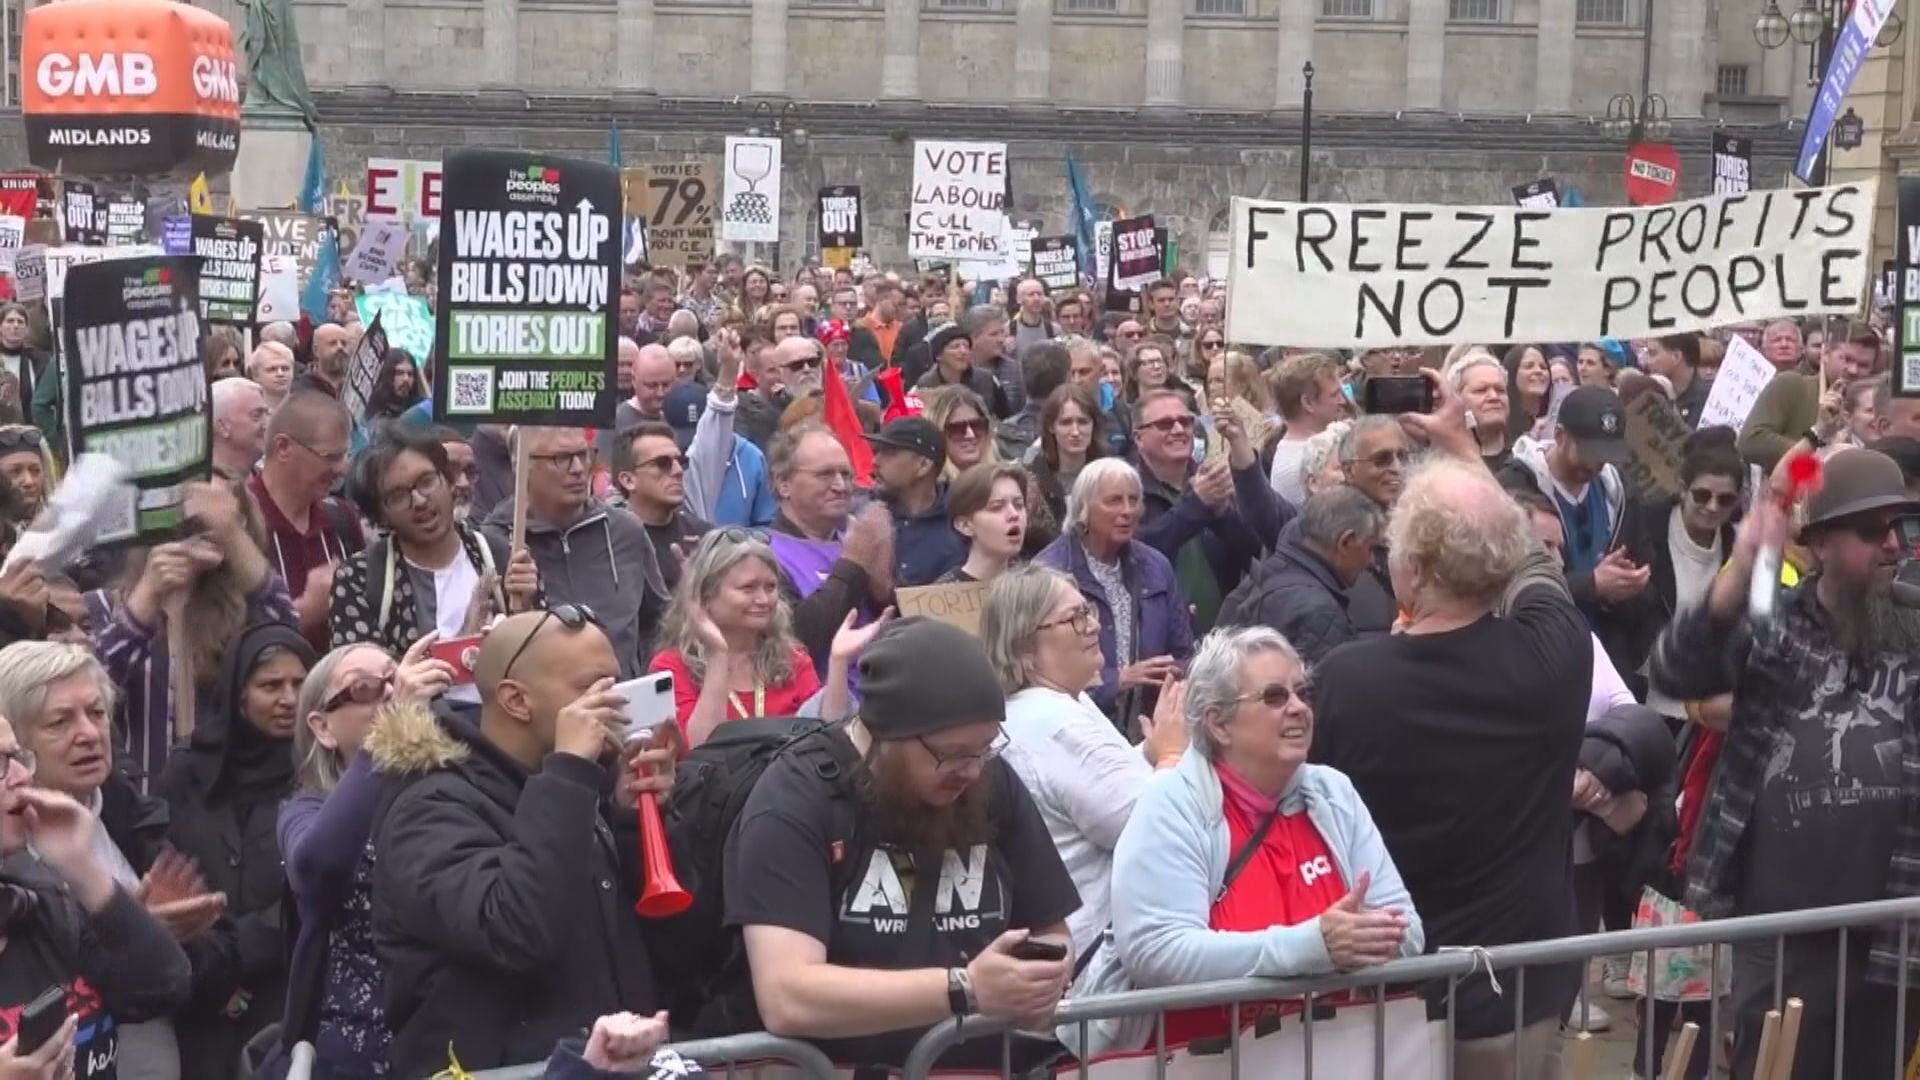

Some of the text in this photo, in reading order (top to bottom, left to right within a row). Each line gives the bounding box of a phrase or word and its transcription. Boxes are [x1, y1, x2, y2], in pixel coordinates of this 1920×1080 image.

[37, 53, 157, 96] GMB
[193, 55, 239, 102] GMB
[48, 129, 151, 145] MIDLANDS
[653, 165, 702, 176] TORIES
[925, 149, 1001, 175] VOTE
[1714, 153, 1749, 180] TORIES
[506, 179, 560, 193] peoples
[509, 169, 526, 180] the
[509, 192, 557, 205] assembly
[821, 197, 857, 211] TORIES
[914, 184, 1004, 210] LABOUR
[67, 206, 94, 230] OUT
[823, 210, 857, 232] OUT
[916, 211, 972, 230] CULL
[1247, 207, 1553, 272] FREEZE
[1596, 186, 1859, 272] PROFITS
[454, 208, 609, 260] WAGES UP
[1117, 228, 1155, 251] STOP
[195, 237, 257, 261] WAGES UP
[222, 261, 255, 280] DOWN
[229, 282, 253, 300] OUT
[450, 262, 609, 308] BILLS DOWN
[1355, 277, 1551, 339] NOT
[1599, 249, 1862, 336] PEOPLE
[455, 313, 546, 355] TORIES
[550, 314, 602, 355] OUT
[76, 315, 178, 378] WAGES
[499, 371, 528, 390] JOIN
[530, 371, 549, 389] THE
[80, 372, 157, 428] BILLS
[498, 391, 596, 411] ASSEMBLY TODAY
